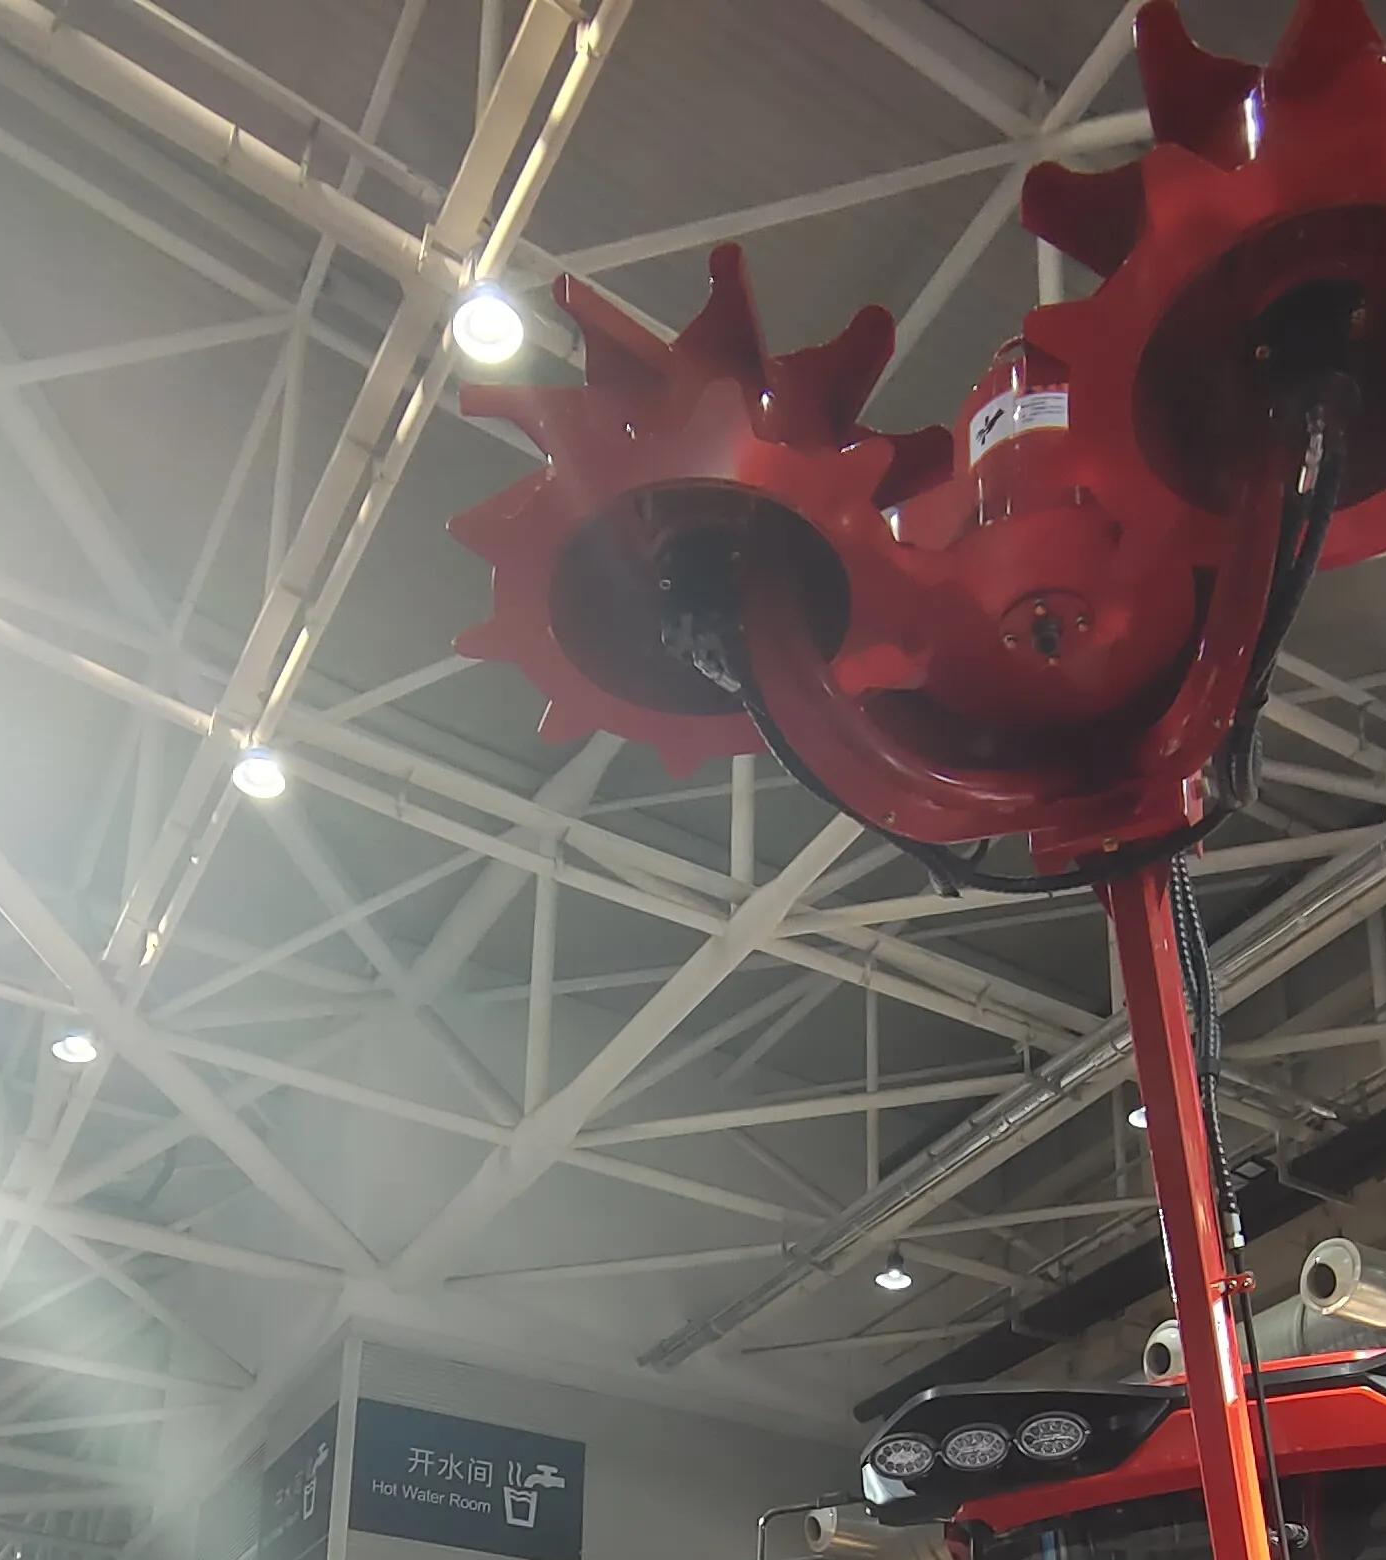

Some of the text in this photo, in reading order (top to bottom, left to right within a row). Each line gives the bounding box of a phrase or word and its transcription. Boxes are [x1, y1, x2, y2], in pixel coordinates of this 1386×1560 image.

[408, 1447, 493, 1488] 开水间
[372, 1479, 492, 1513] Hot Water Room
